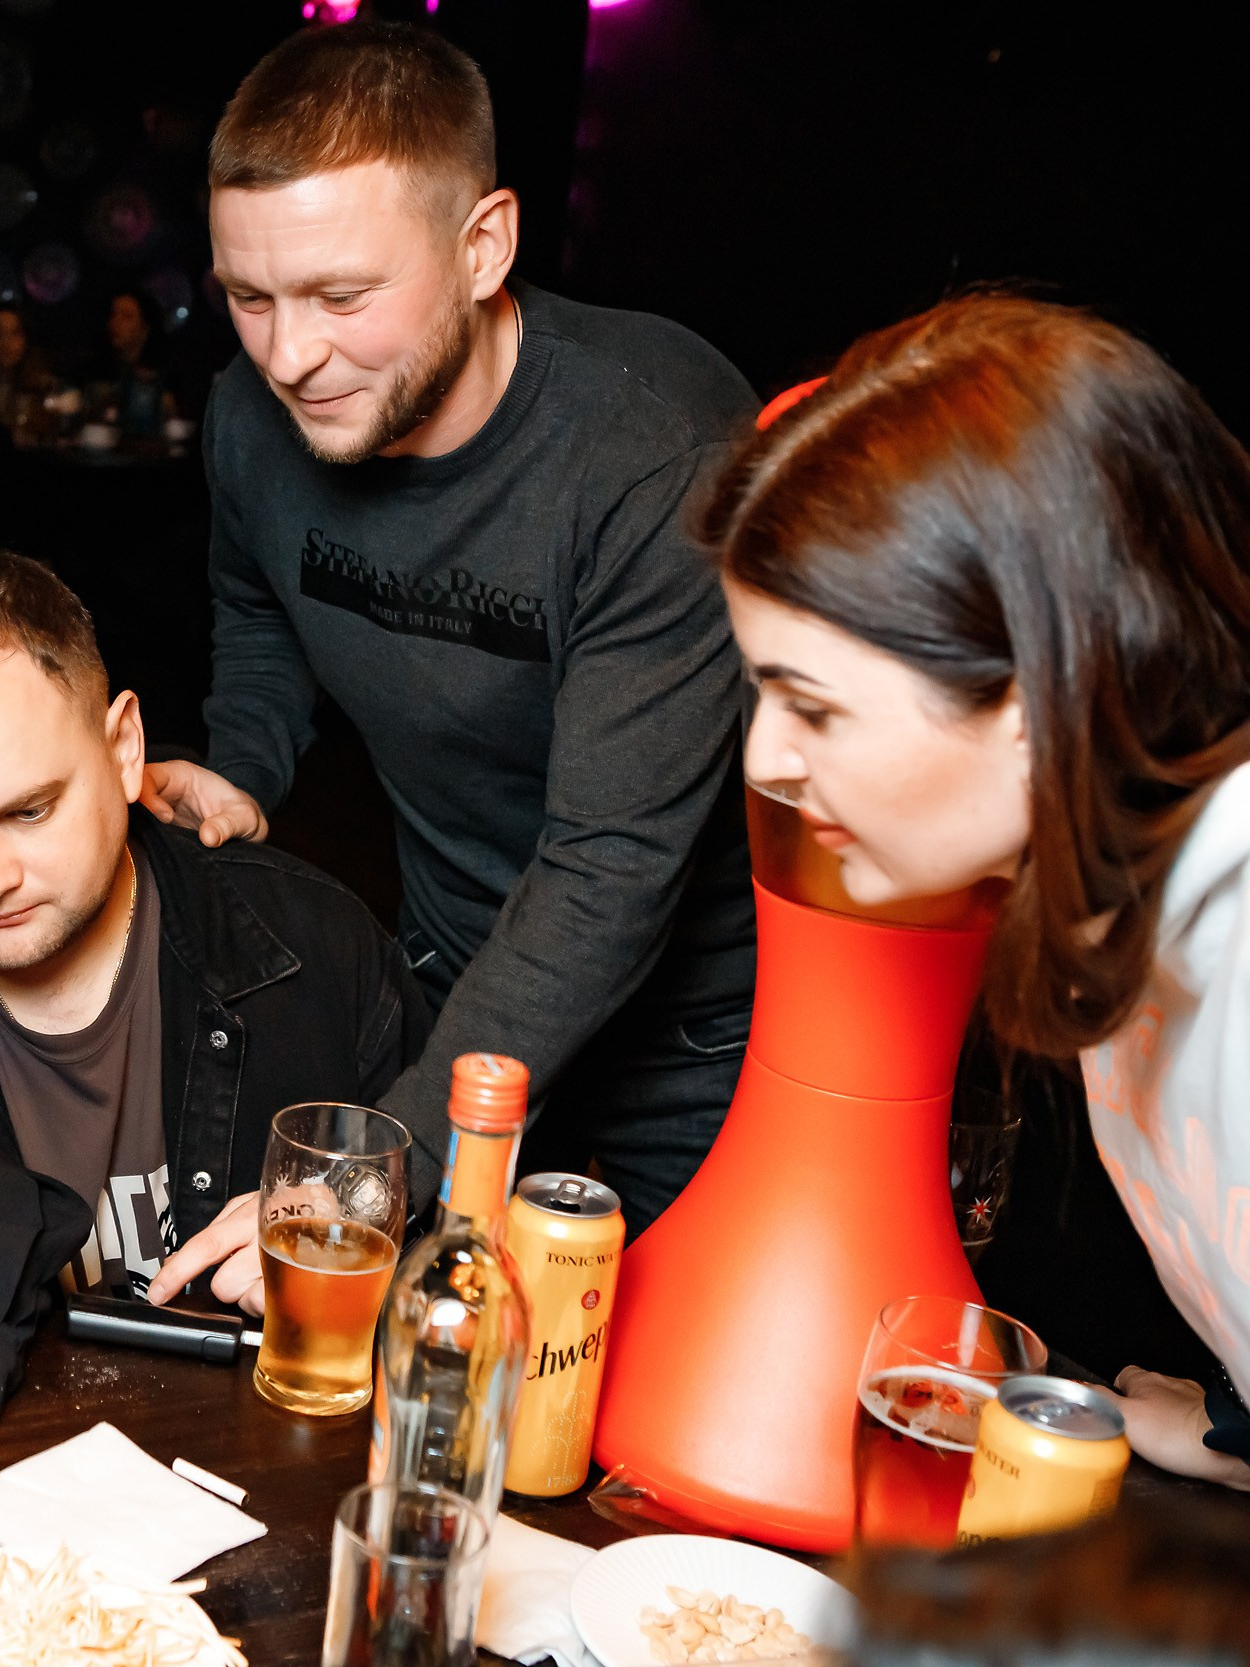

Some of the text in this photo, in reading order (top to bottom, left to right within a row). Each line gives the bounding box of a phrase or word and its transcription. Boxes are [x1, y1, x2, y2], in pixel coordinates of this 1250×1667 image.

[447, 567, 546, 631] RICCI
[369, 600, 473, 635] MADE IN ITALY
[546, 1252, 594, 1268] TONIC
